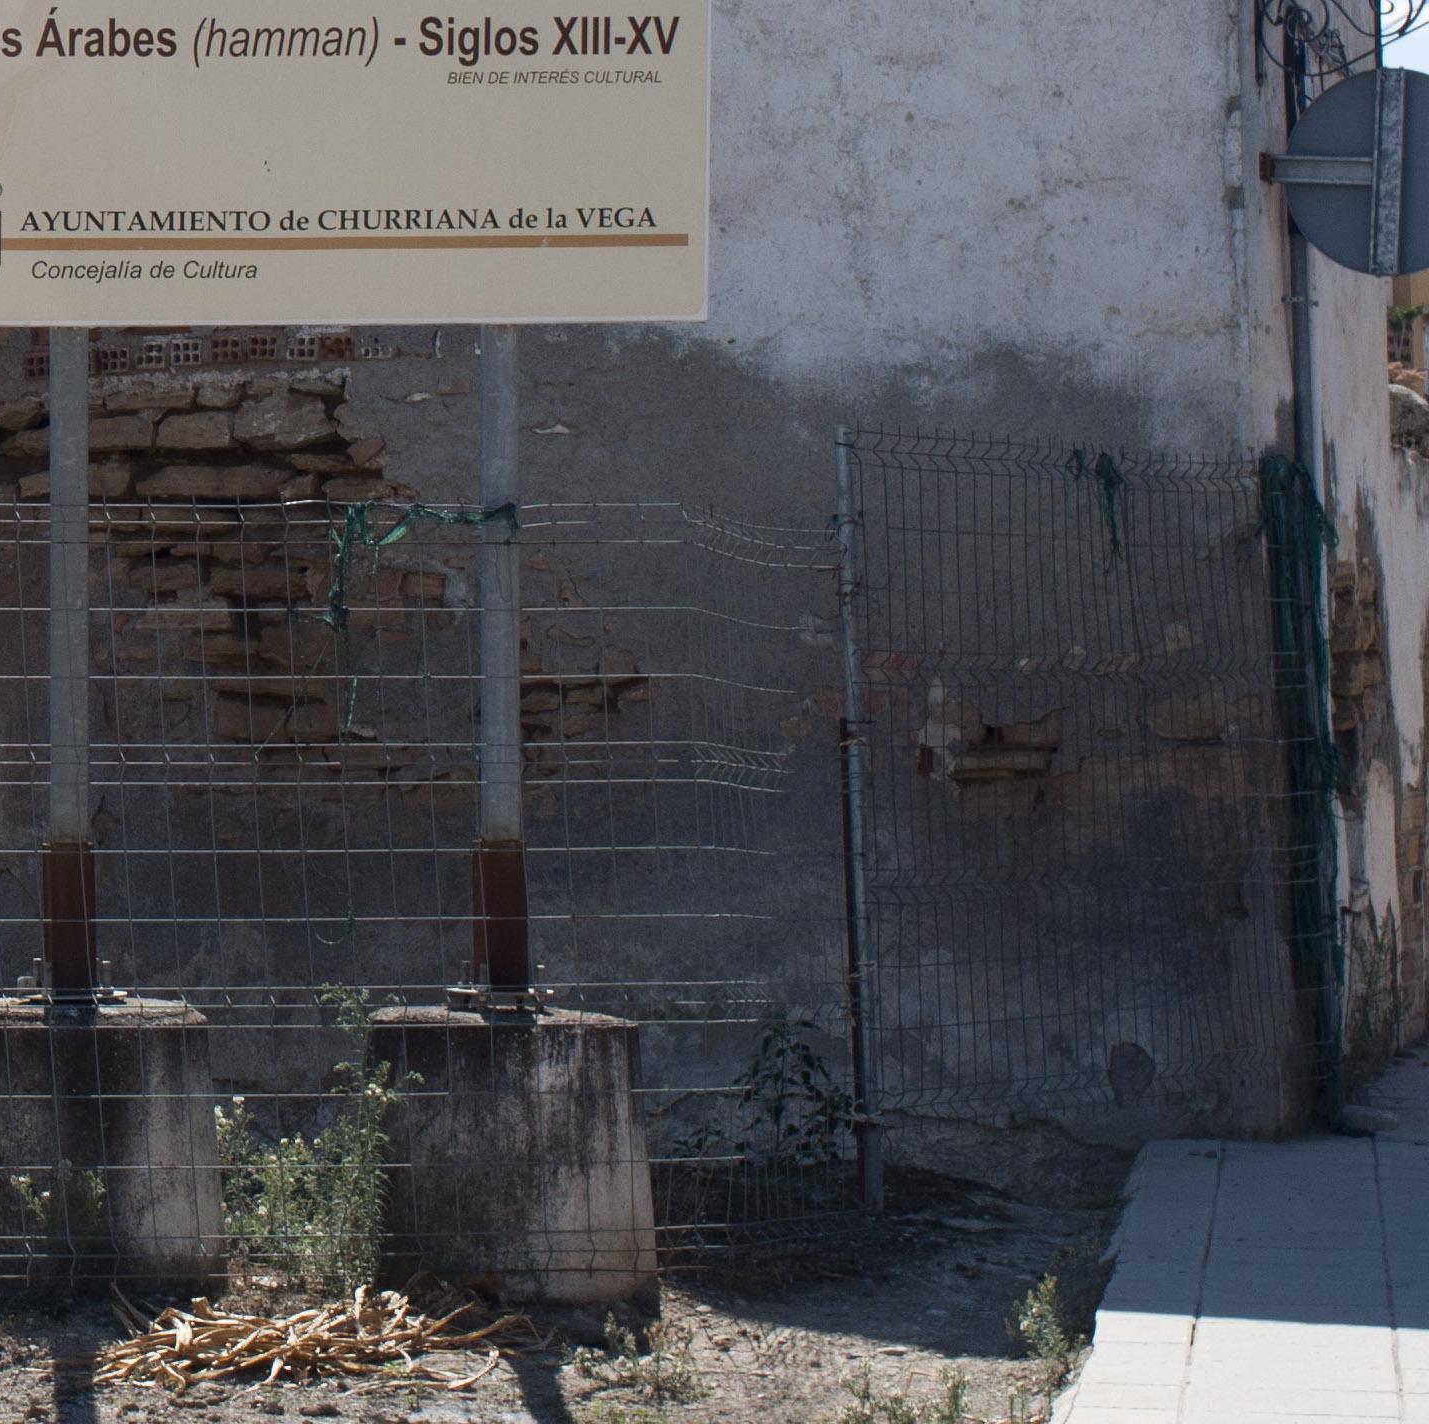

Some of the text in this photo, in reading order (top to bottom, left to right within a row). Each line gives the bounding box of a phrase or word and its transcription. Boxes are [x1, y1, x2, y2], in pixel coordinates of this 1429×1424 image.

[35, 6, 178, 58] Árabes
[191, 16, 379, 69] (hamman)
[393, 37, 407, 46] -
[418, 15, 539, 67] Siglos
[551, 15, 681, 56] XIII-XV
[446, 68, 662, 85] BIEN DE INTERÉS CULTURAL
[19, 206, 657, 232] AYUNTAMIENTO de CHURRIANA de la VEGA
[31, 259, 258, 284] Concejalía de Cultura
